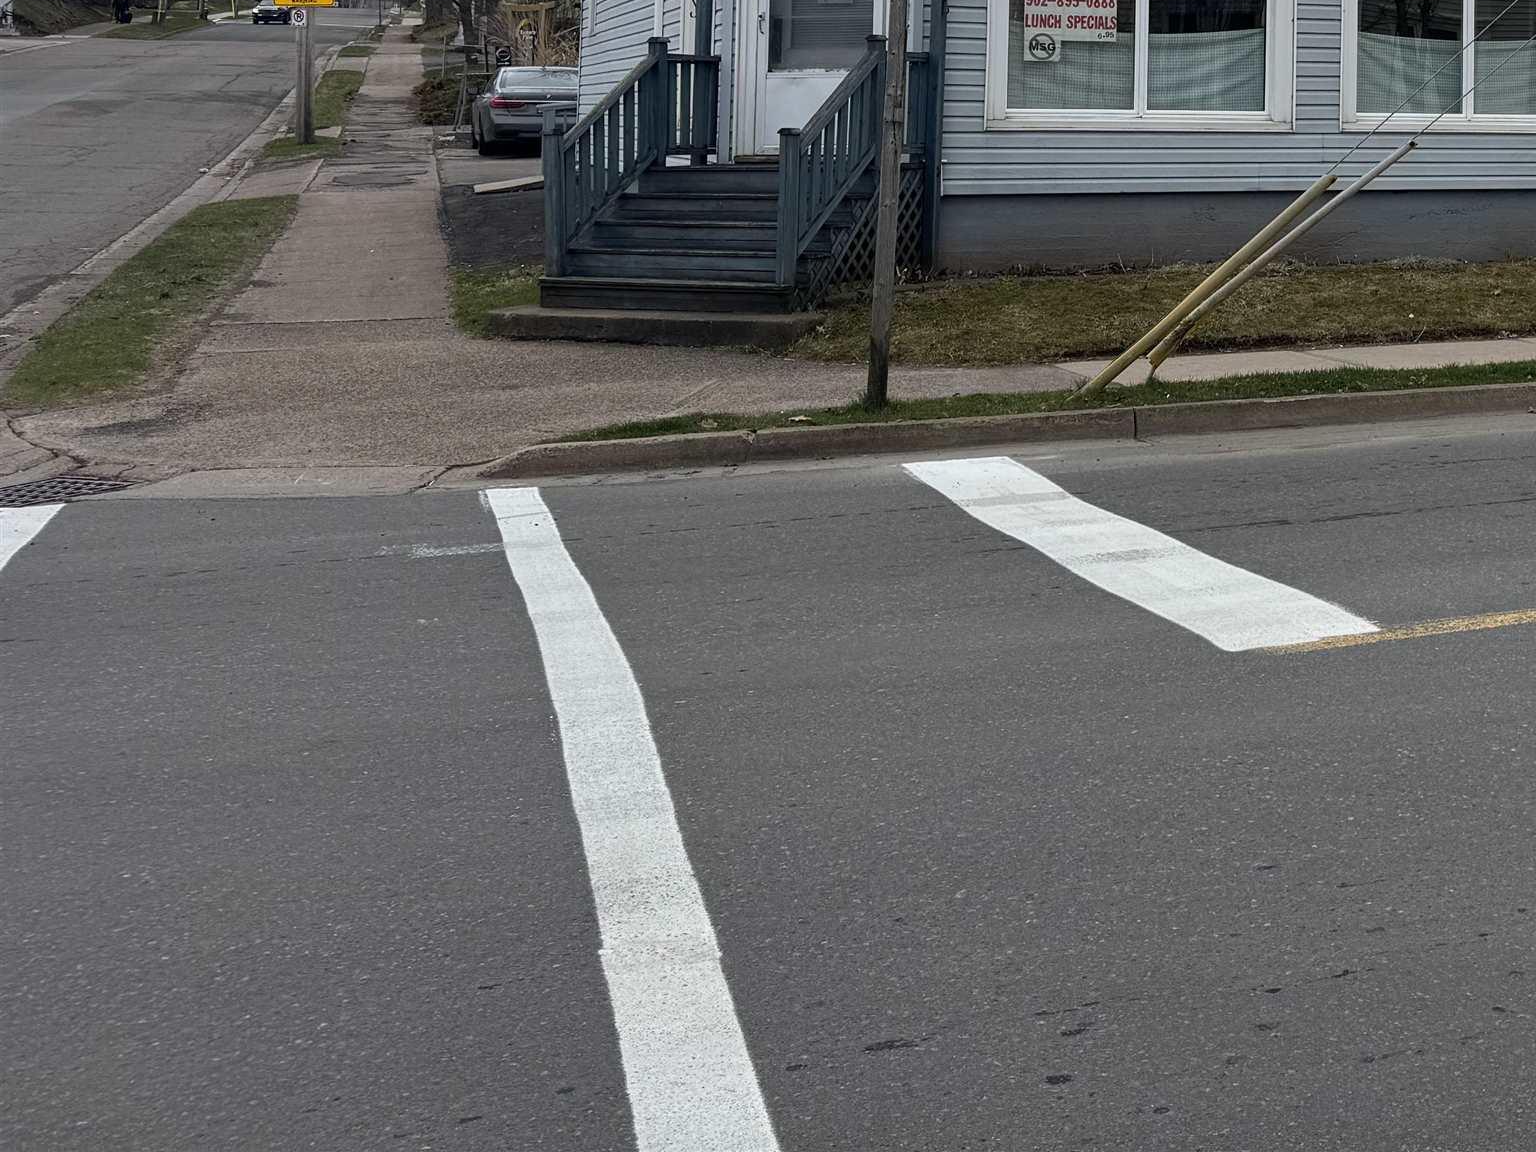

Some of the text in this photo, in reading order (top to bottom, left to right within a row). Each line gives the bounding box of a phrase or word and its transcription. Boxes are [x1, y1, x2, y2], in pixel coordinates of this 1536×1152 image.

[1025, 14, 1118, 30] LUNCH SPECIALS
[1029, 40, 1056, 51] MSG
